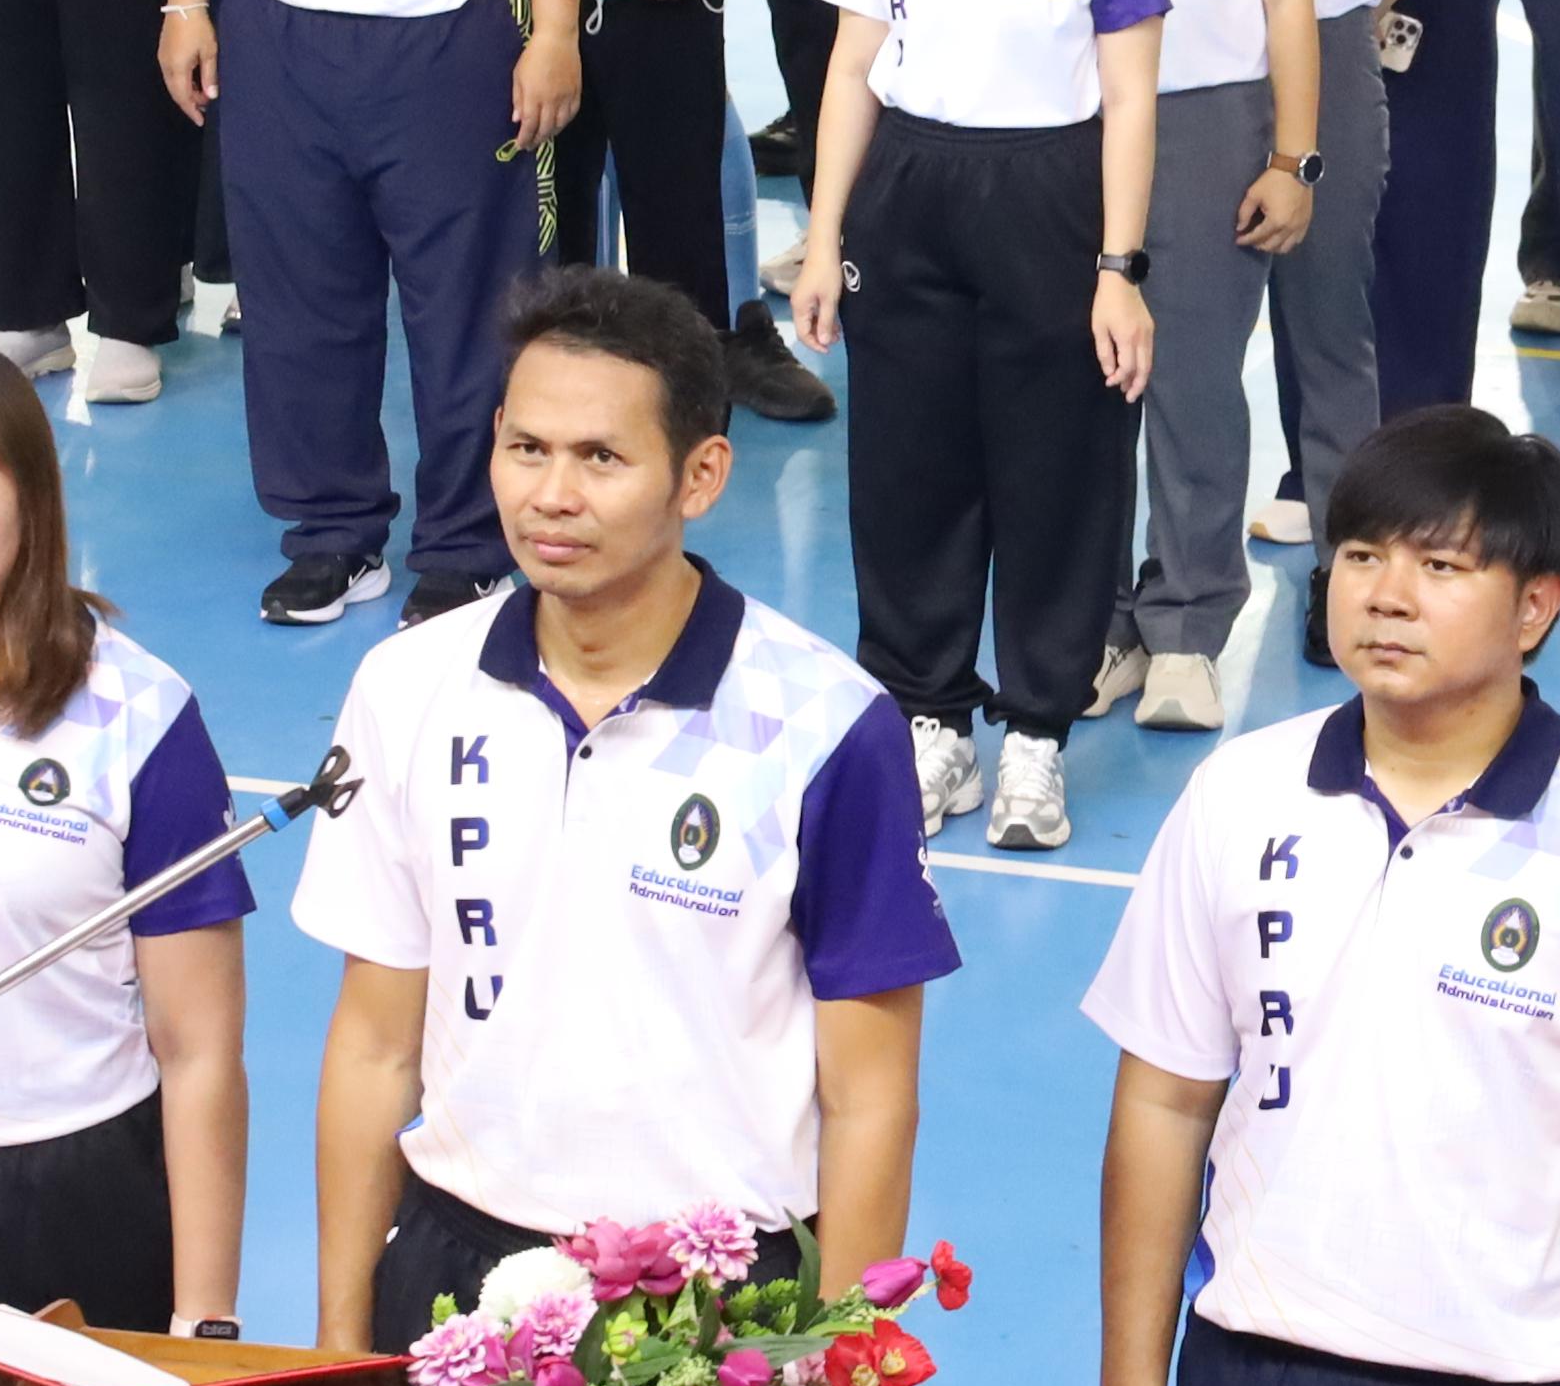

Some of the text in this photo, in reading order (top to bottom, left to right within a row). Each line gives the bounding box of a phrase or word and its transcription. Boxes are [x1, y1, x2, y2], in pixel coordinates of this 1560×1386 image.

[449, 734, 504, 1022] KPRU
[630, 864, 744, 903] Educational
[1436, 981, 1554, 1021] Administration
[1438, 963, 1557, 1006] Educational
